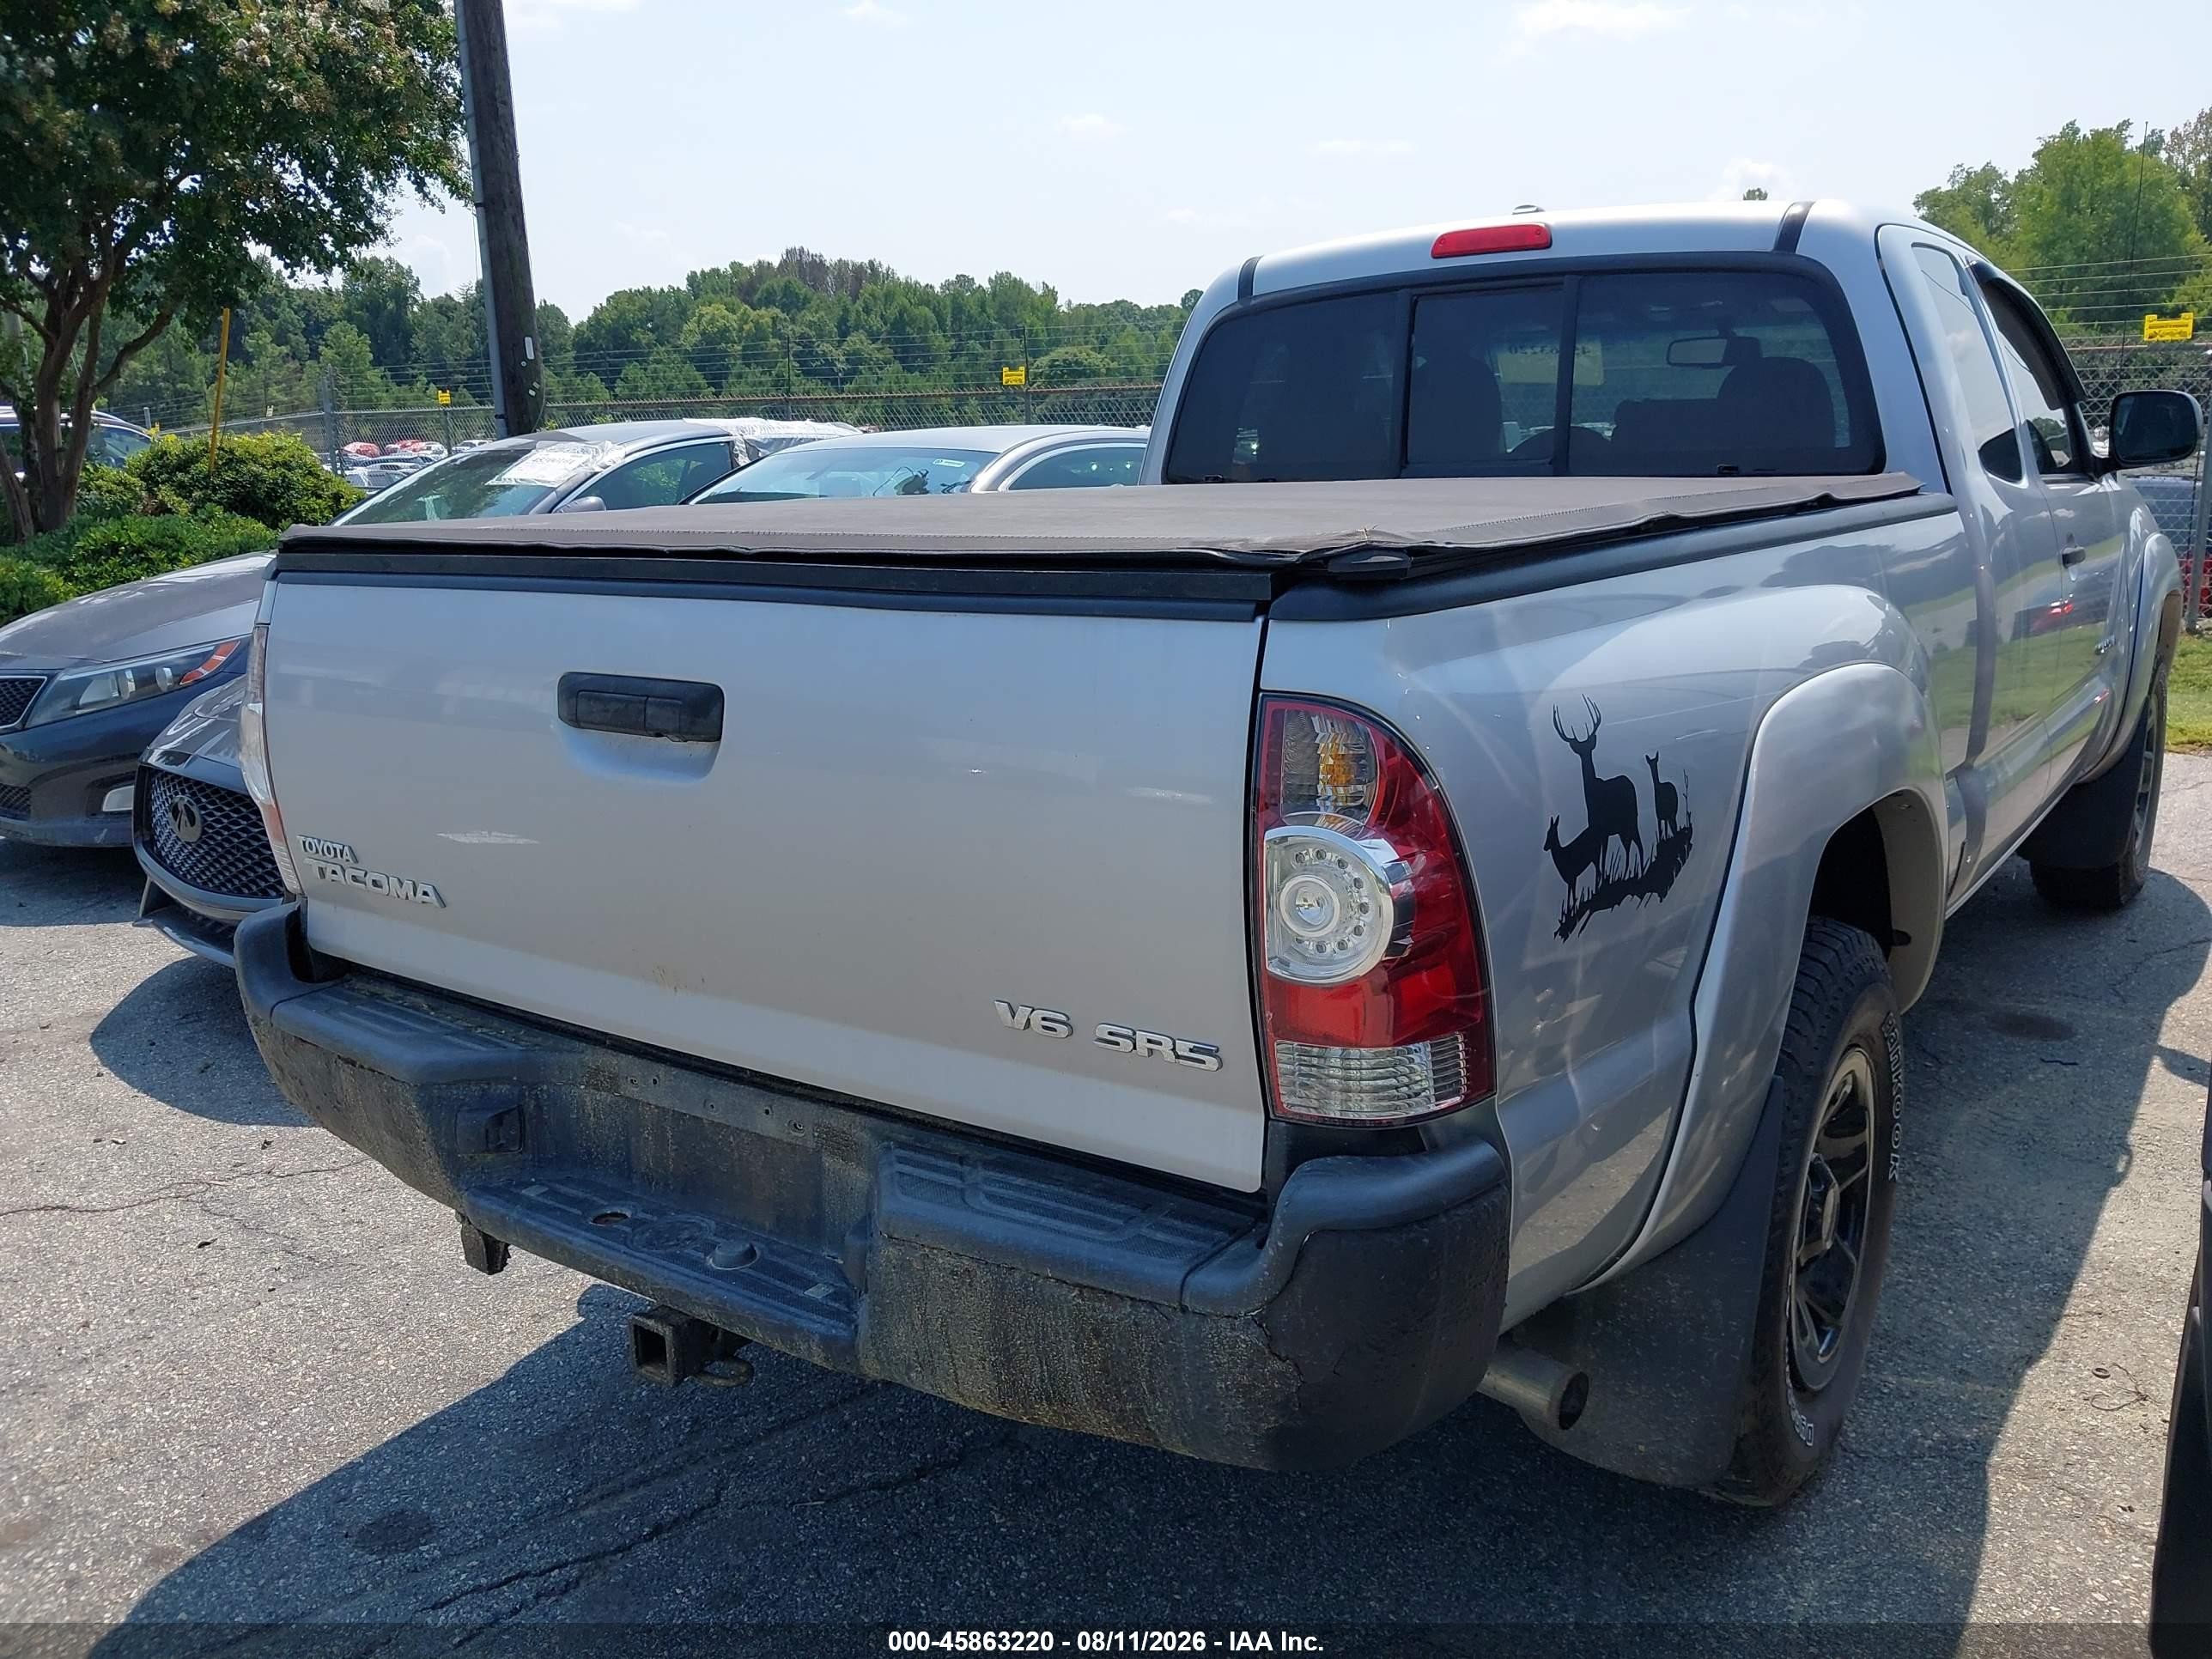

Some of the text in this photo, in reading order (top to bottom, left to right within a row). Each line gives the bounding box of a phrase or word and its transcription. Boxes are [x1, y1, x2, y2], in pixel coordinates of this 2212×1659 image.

[297, 835, 358, 864] TOYOTA
[304, 857, 447, 908] TACOMA
[994, 1000, 1224, 1072] V6 SR5
